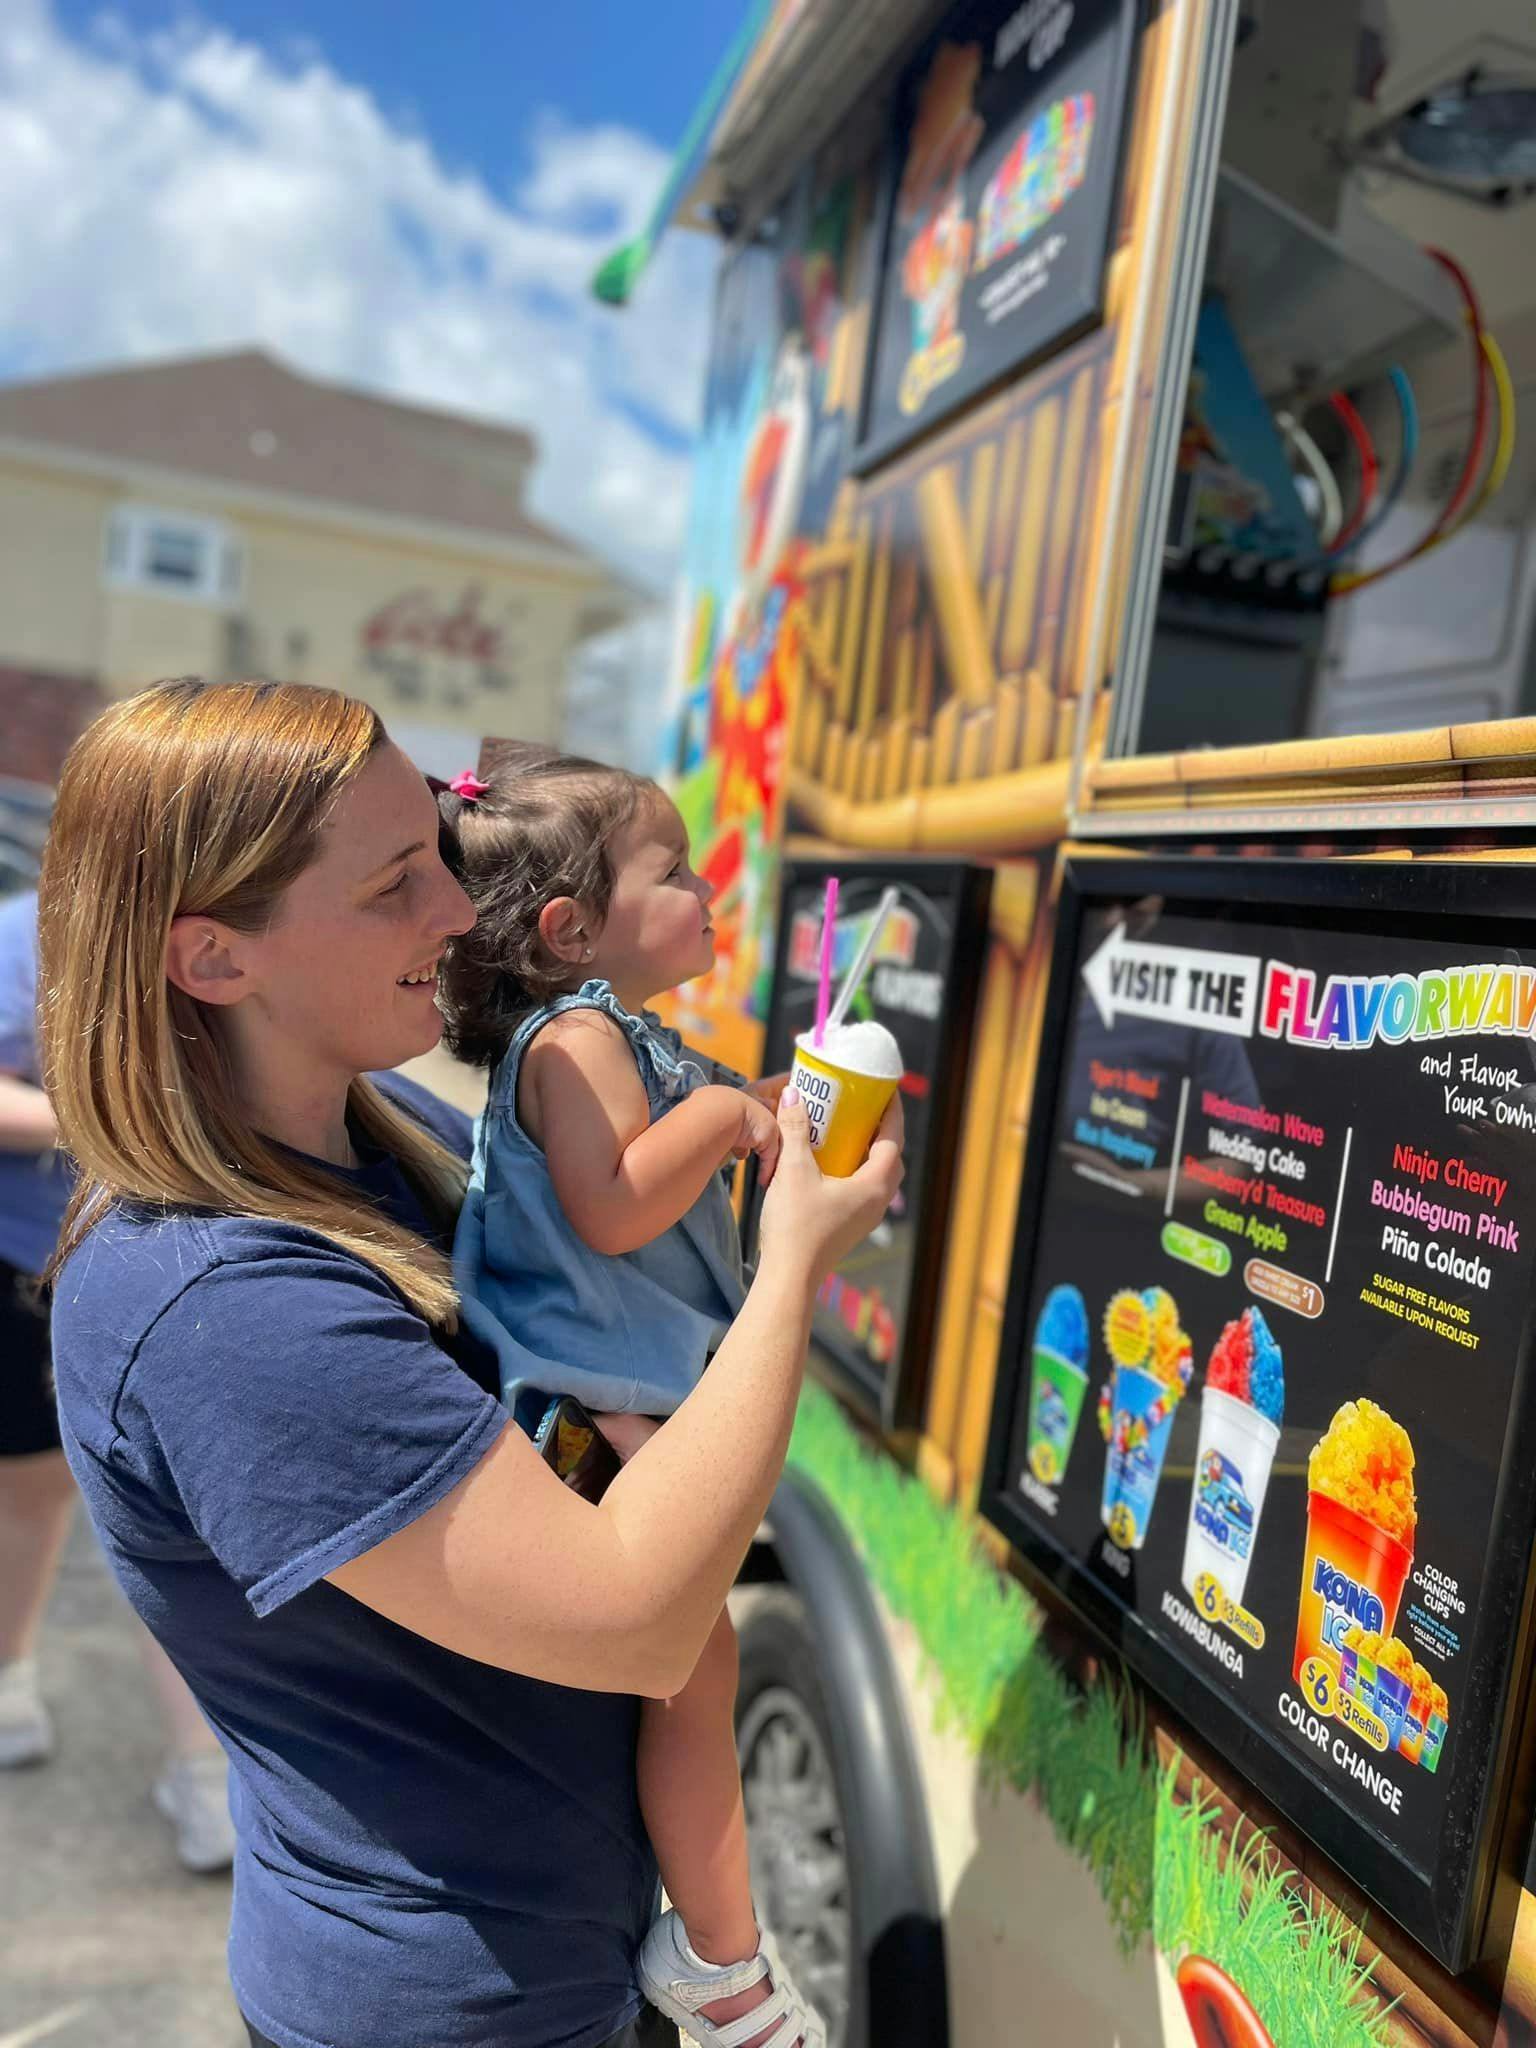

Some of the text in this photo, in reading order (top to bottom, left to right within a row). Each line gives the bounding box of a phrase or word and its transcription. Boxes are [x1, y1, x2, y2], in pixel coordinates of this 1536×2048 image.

[1109, 956, 1178, 1006] VISIT
[1187, 969, 1246, 1019] THE
[796, 1068, 831, 1103] GOOD.
[1420, 1051, 1452, 1078] and
[1202, 1090, 1325, 1147] Watermelon Wave
[1208, 1127, 1306, 1180] Wedding Cake
[1392, 1143, 1508, 1207] Ninja Cherry
[1204, 1199, 1245, 1234] Green
[1245, 1215, 1288, 1252] Apple
[1266, 1185, 1326, 1227] Treasure
[1370, 1179, 1520, 1252] Bubblegum Pink
[1381, 1225, 1491, 1290] Piña Colada
[1302, 1286, 1315, 1310] $1
[1360, 1288, 1480, 1349] AVAILABLE UPON REQUEST
[1372, 1273, 1471, 1324] SUGAR FREE FLAVORS
[1312, 1557, 1383, 1634] KONA
[1413, 1571, 1466, 1614] CHANGING
[1424, 1593, 1450, 1619] CUPS
[1425, 1564, 1458, 1595] COLOR
[1161, 1591, 1244, 1679] KOWABUNGA
[1306, 1663, 1328, 1706] $6
[1338, 1693, 1351, 1721] $3
[1351, 1711, 1383, 1744] Refills
[1278, 1692, 1403, 1815] COLOR CHANGE
